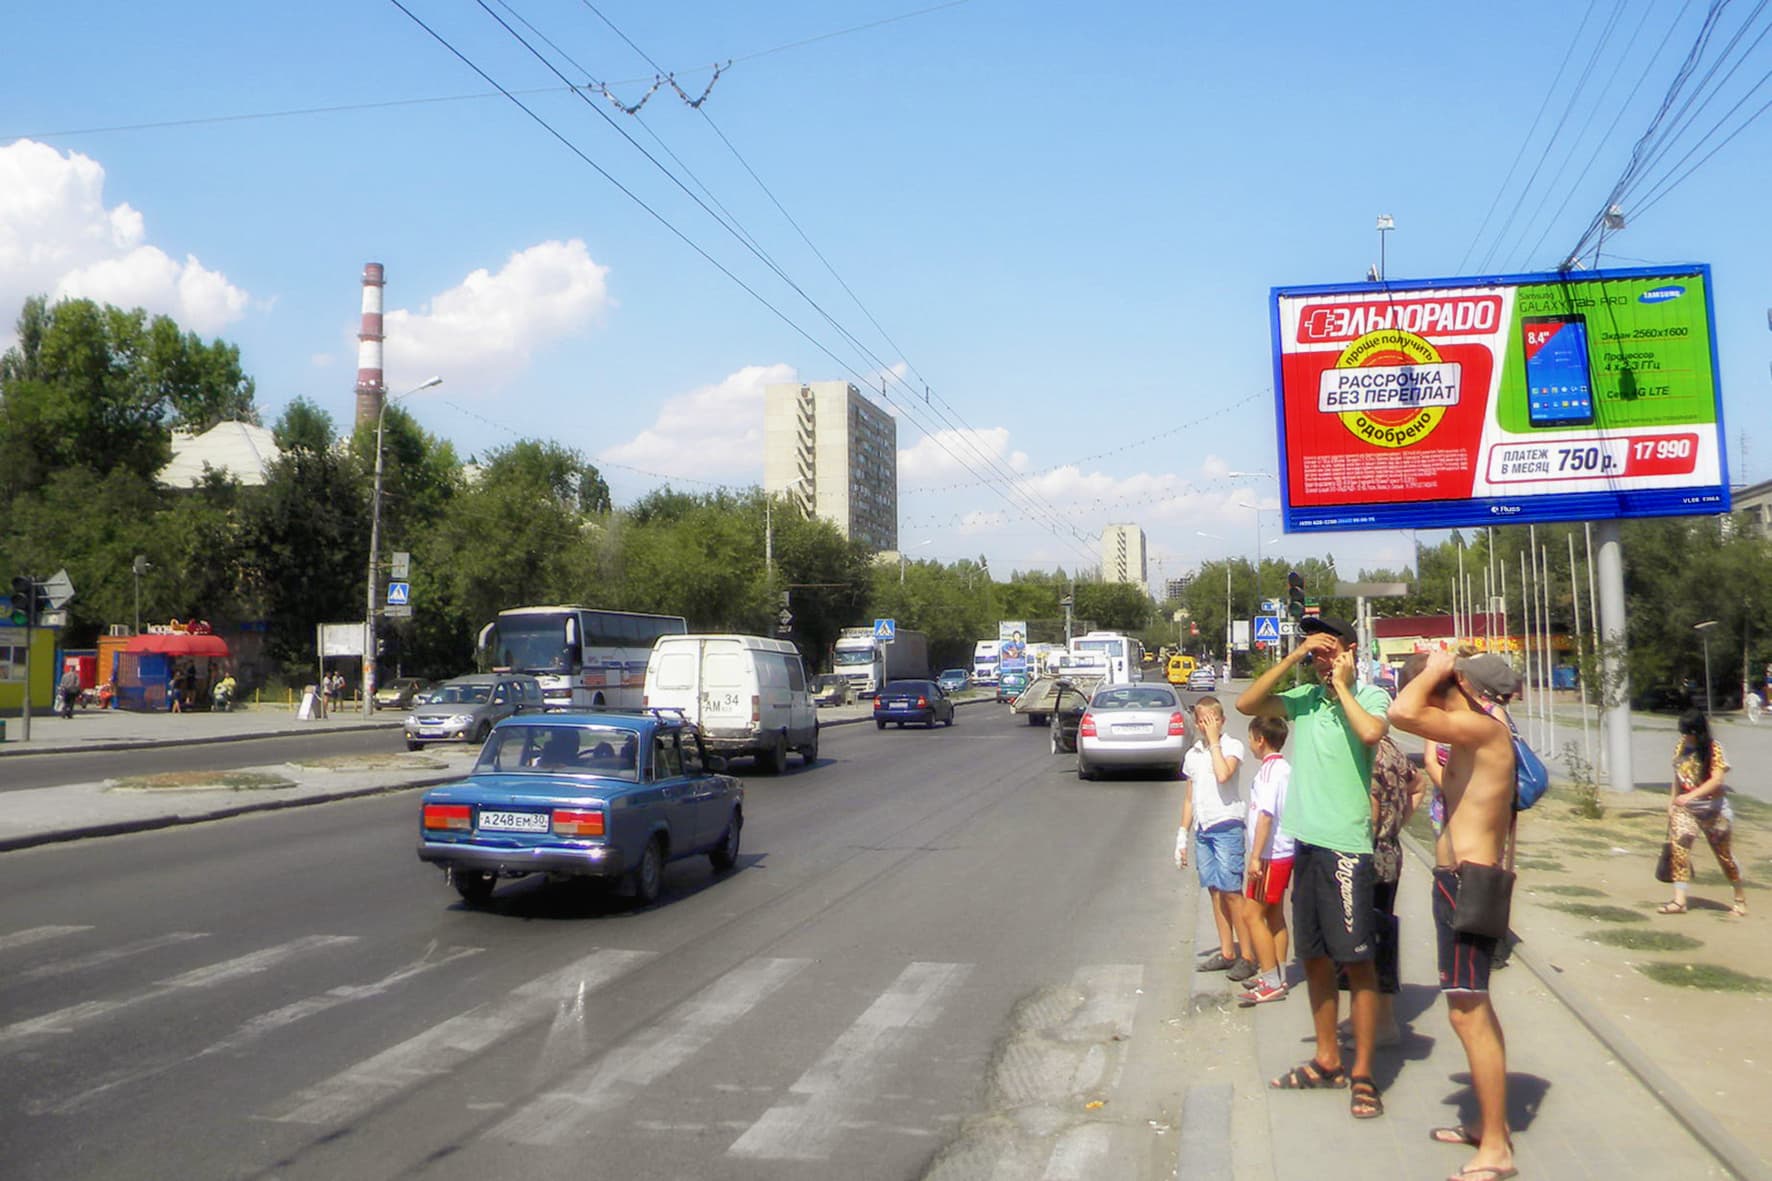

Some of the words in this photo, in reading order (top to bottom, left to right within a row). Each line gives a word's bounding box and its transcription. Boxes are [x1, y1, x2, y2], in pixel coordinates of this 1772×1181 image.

[1519, 292, 1554, 302] Samsung
[1519, 301, 1569, 313] GALAXY
[1571, 297, 1596, 308] Tab
[1600, 295, 1628, 306] PRO
[1601, 332, 1631, 341] Экран
[1346, 336, 1380, 366] проще
[1382, 335, 1434, 362] получить
[1603, 352, 1655, 362] Процессор
[1338, 370, 1442, 389] РАССРОЧКА
[1326, 391, 1360, 406] БЕЗ
[1364, 384, 1456, 404] ПЕРЕПЛАТ
[1649, 386, 1671, 397] LTE
[1356, 412, 1432, 445] одобрено
[1503, 449, 1549, 462] ПЛАТЕЖ
[1634, 441, 1654, 460] 17
[1656, 439, 1691, 459] 990
[1558, 447, 1598, 471] 750
[1501, 463, 1509, 475] В
[1511, 462, 1550, 474] МЕСЯЦ
[724, 694, 739, 706] 34
